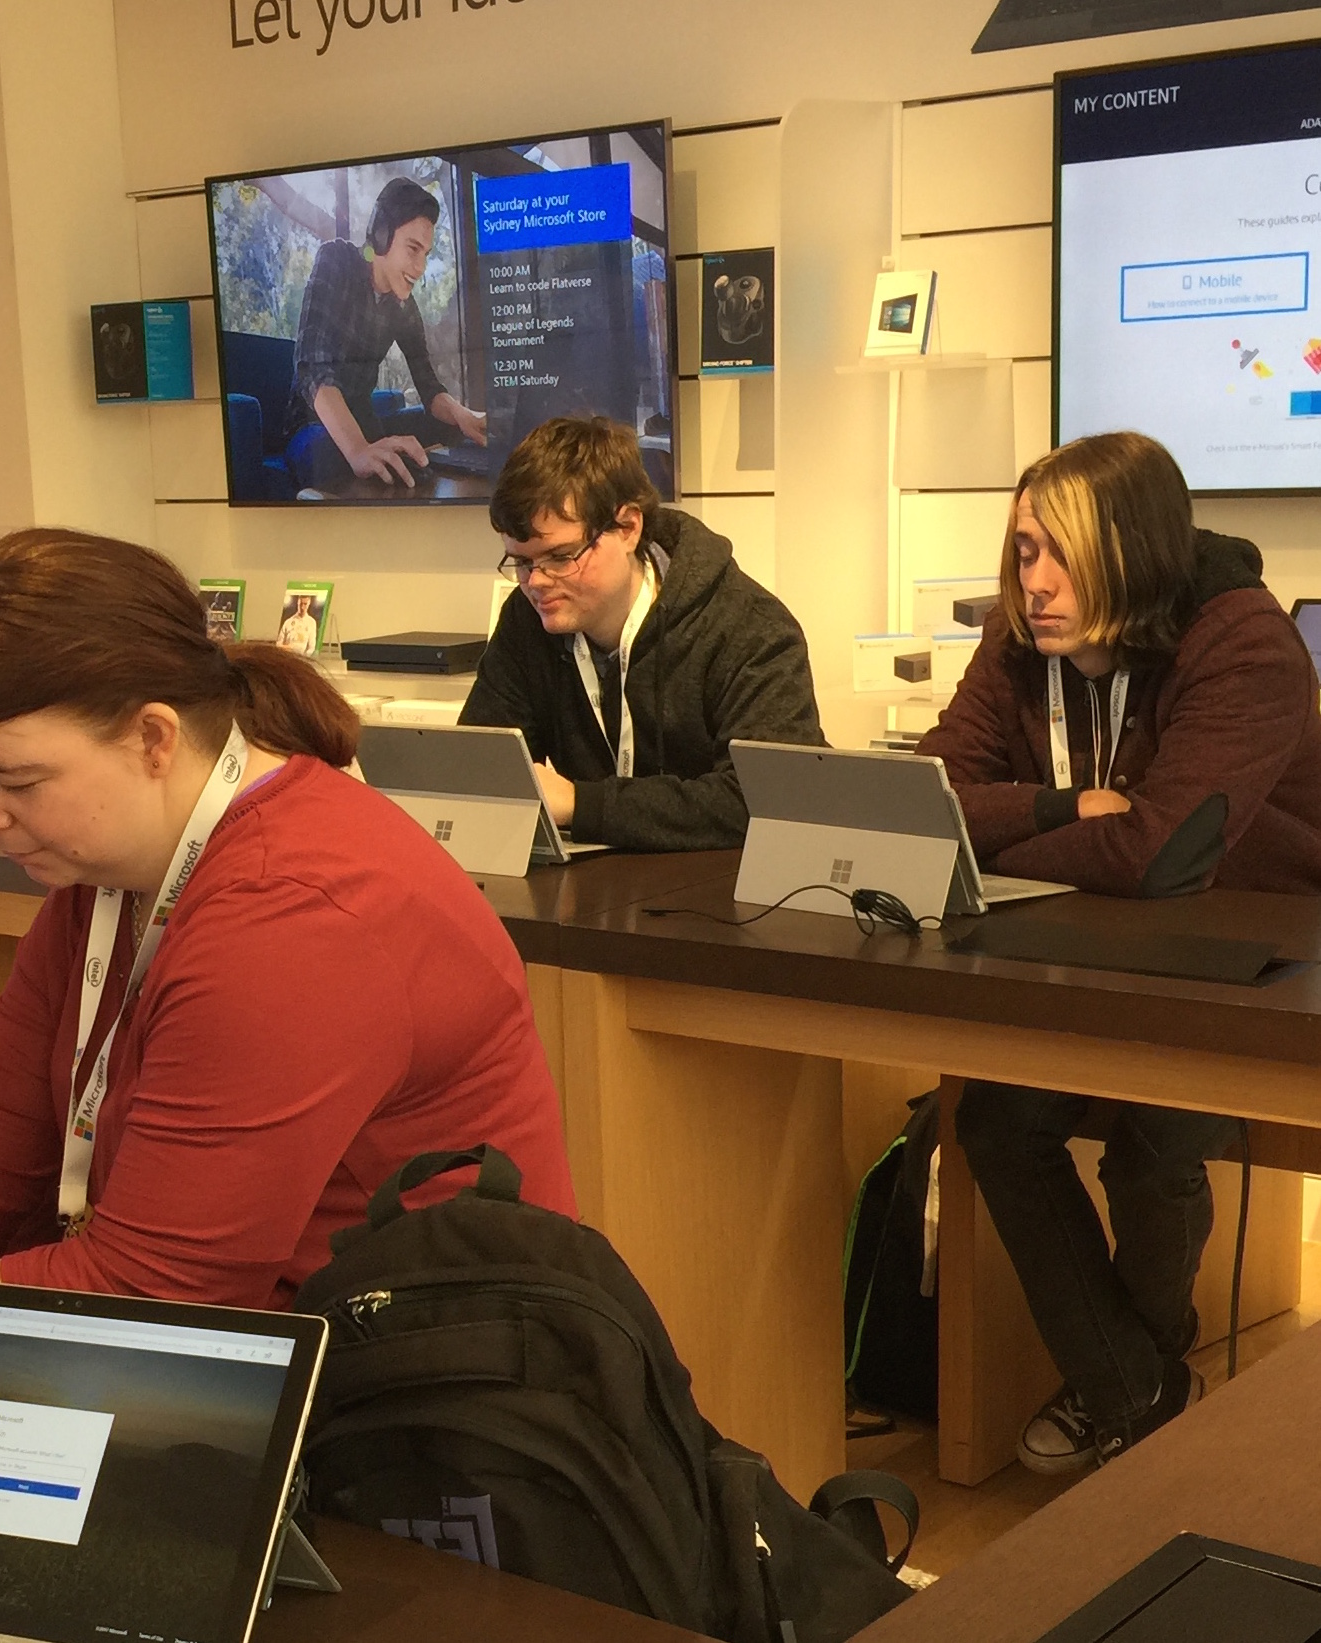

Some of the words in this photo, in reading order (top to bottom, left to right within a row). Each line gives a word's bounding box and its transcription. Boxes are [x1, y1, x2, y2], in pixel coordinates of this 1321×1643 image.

[230, 0, 301, 49] Let
[1074, 97, 1098, 114] MY
[1102, 86, 1180, 111] CONTENT
[483, 196, 528, 213] Saturday
[532, 196, 542, 209] at
[545, 194, 569, 211] your
[484, 218, 521, 235] Sydney
[524, 210, 574, 228] Microsoft
[578, 209, 607, 223] Store
[489, 266, 513, 279] 10:00
[515, 264, 530, 277] AM
[489, 283, 514, 295] Learn
[516, 281, 525, 293] to
[528, 278, 550, 292] code
[552, 276, 592, 290] Flatverse
[1199, 273, 1243, 290] Mobile
[491, 304, 514, 317] 12:00
[516, 303, 531, 315] PM
[491, 320, 523, 334] League
[525, 318, 535, 330] of
[536, 315, 574, 331] Legends
[492, 334, 545, 347] Tournament
[519, 359, 534, 371] PM
[493, 375, 518, 388] STEM
[520, 373, 560, 388] Saturday
[223, 756, 239, 782] intel
[165, 839, 203, 904] Microsoft
[88, 959, 102, 985] intel
[82, 1054, 106, 1119] Microsoft
